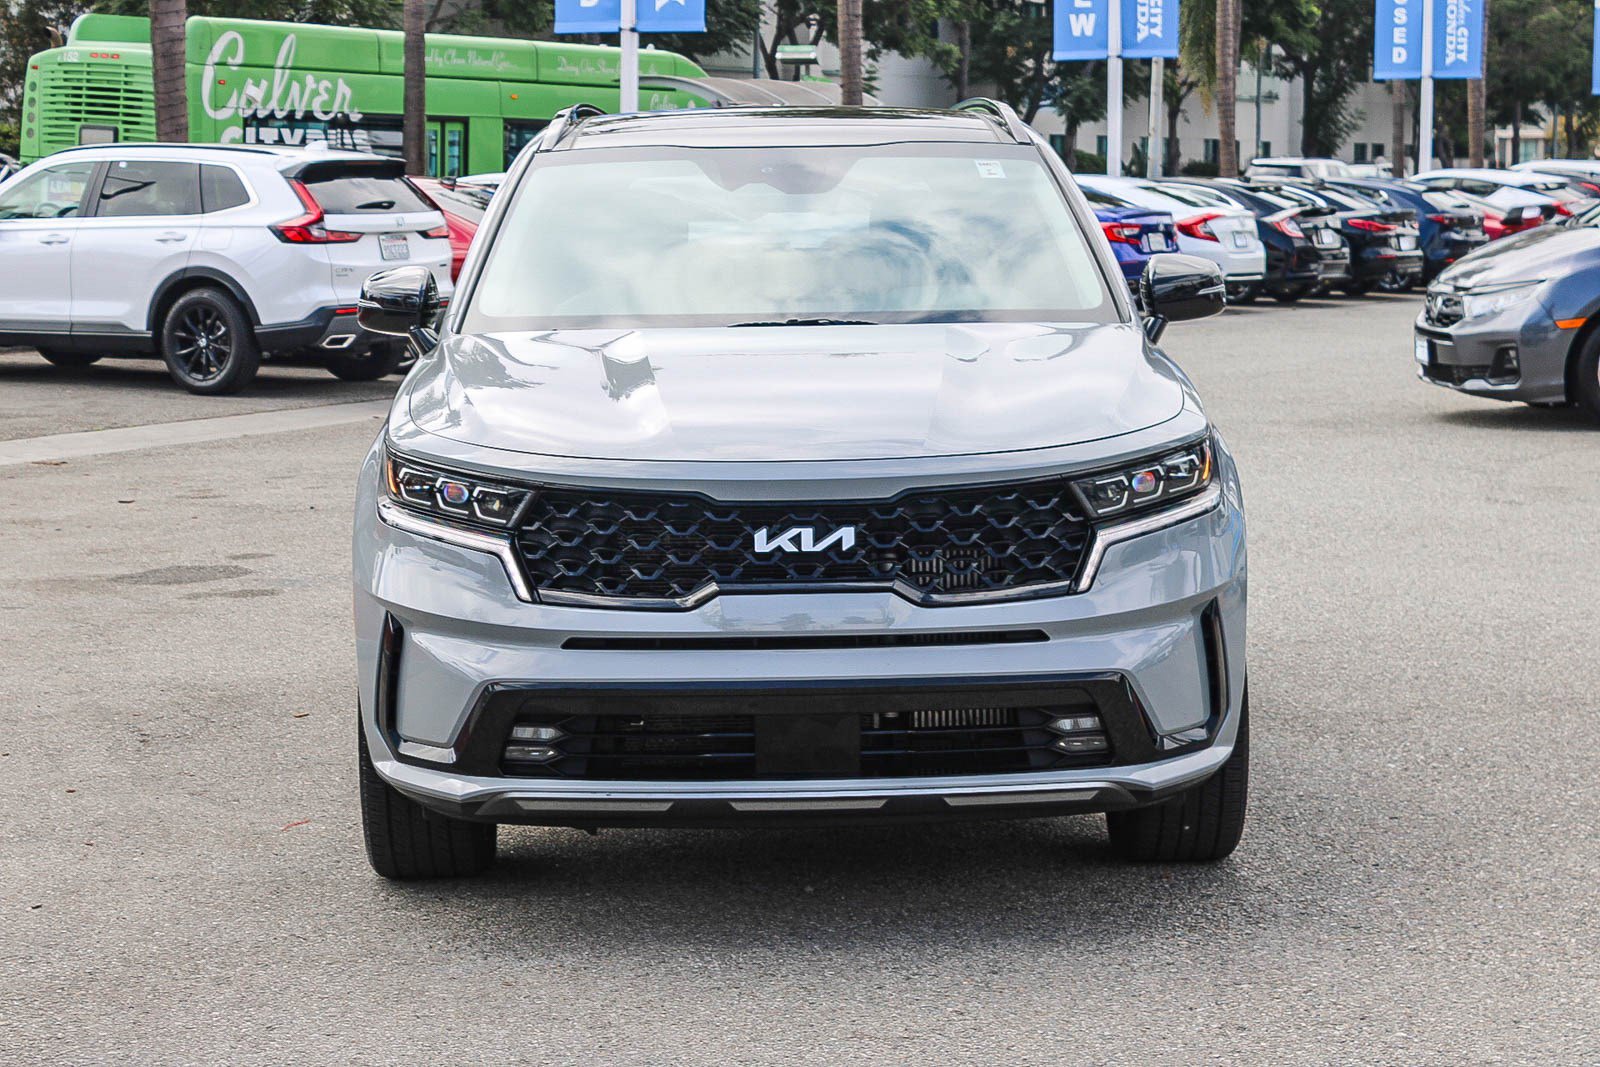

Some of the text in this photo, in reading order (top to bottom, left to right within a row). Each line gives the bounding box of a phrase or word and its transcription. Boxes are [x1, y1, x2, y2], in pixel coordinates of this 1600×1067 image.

[1456, 27, 1469, 64] CITY
[201, 30, 363, 122] Culver
[754, 526, 856, 552] KIA
